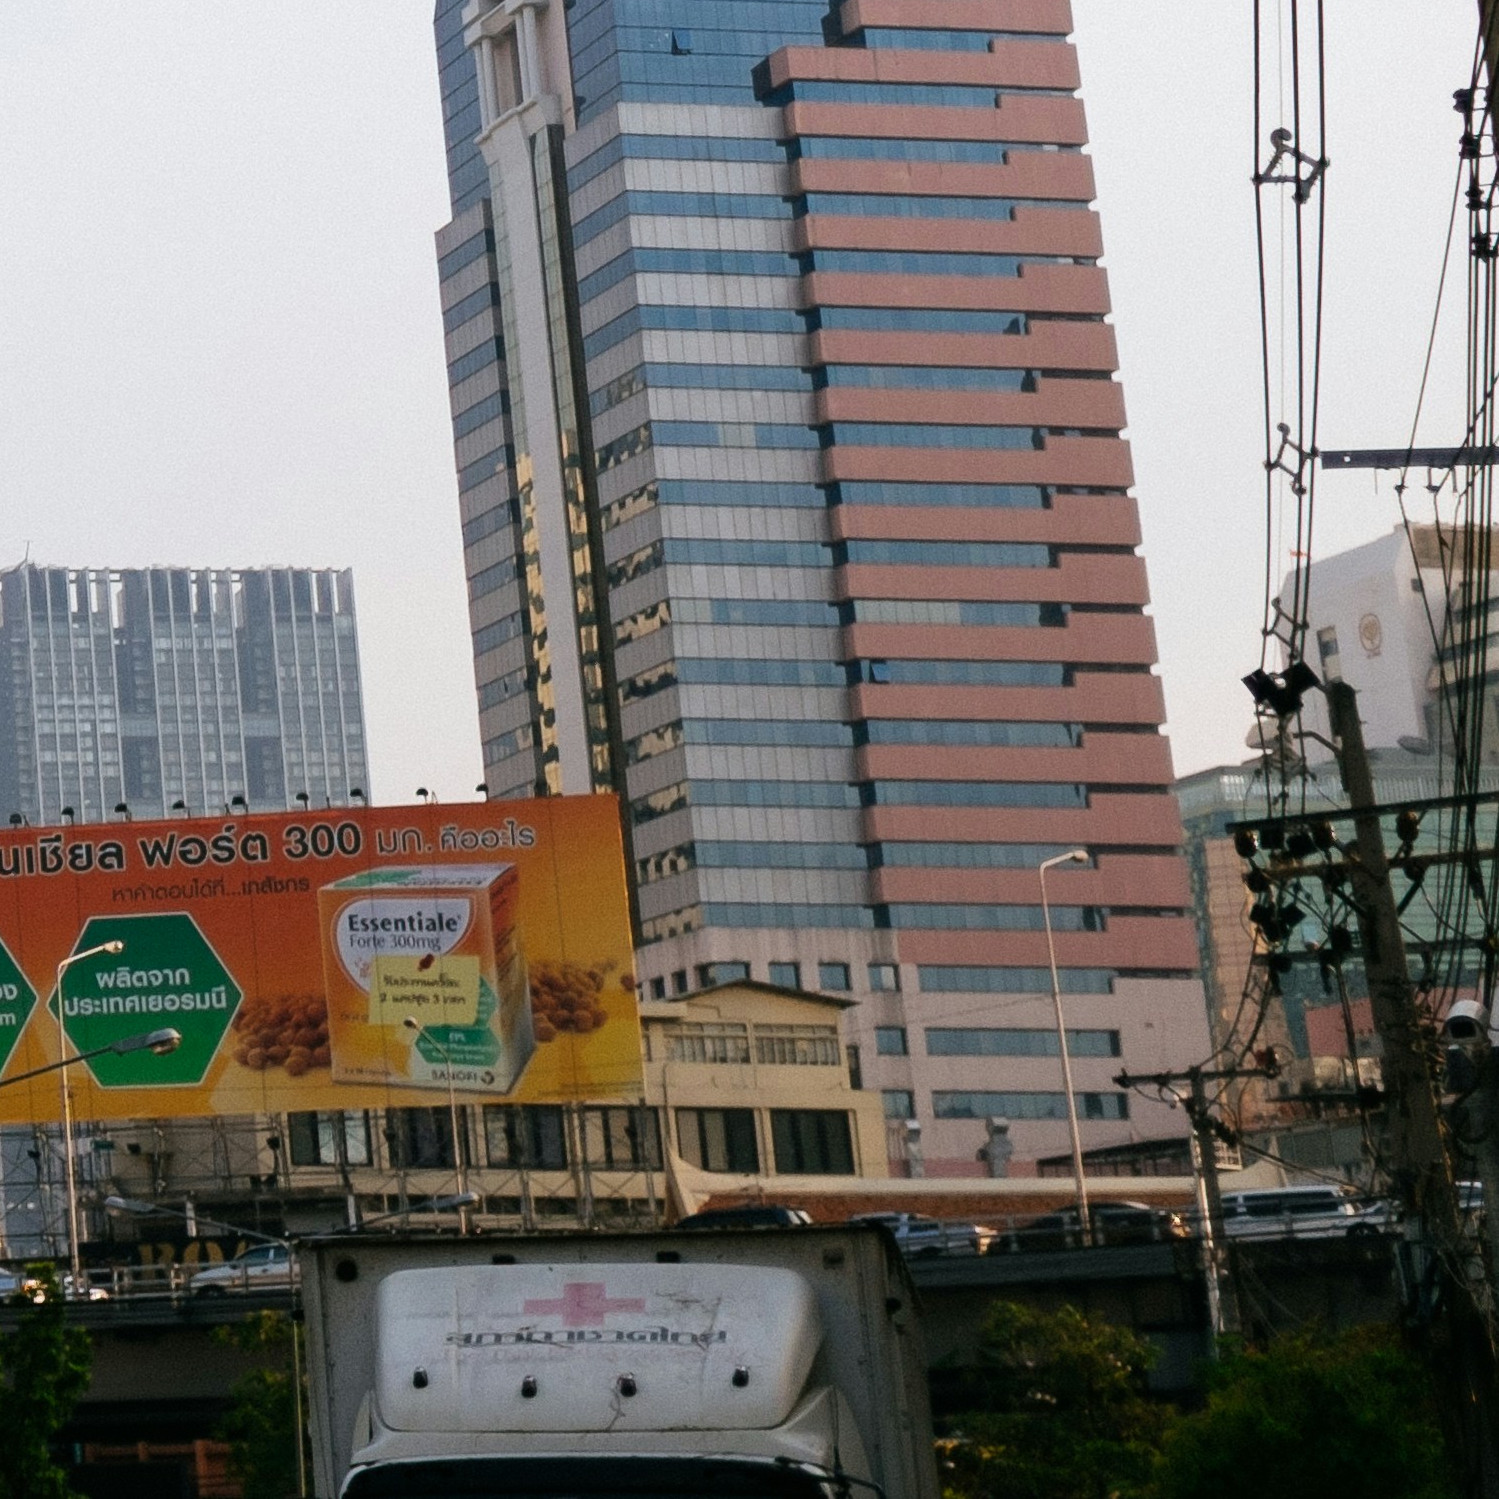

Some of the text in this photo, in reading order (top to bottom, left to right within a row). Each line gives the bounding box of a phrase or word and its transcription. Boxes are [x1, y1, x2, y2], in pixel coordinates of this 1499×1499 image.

[139, 824, 269, 869] ฟอร์ต
[283, 821, 361, 861] 300
[376, 827, 433, 854] มก.
[440, 817, 537, 851] คืออะไร
[348, 911, 459, 933] Essentiale
[349, 934, 442, 951] Forte 300mg
[95, 967, 190, 989] ผลิตจาก
[64, 986, 227, 1016] ประเทศเยอรมนี
